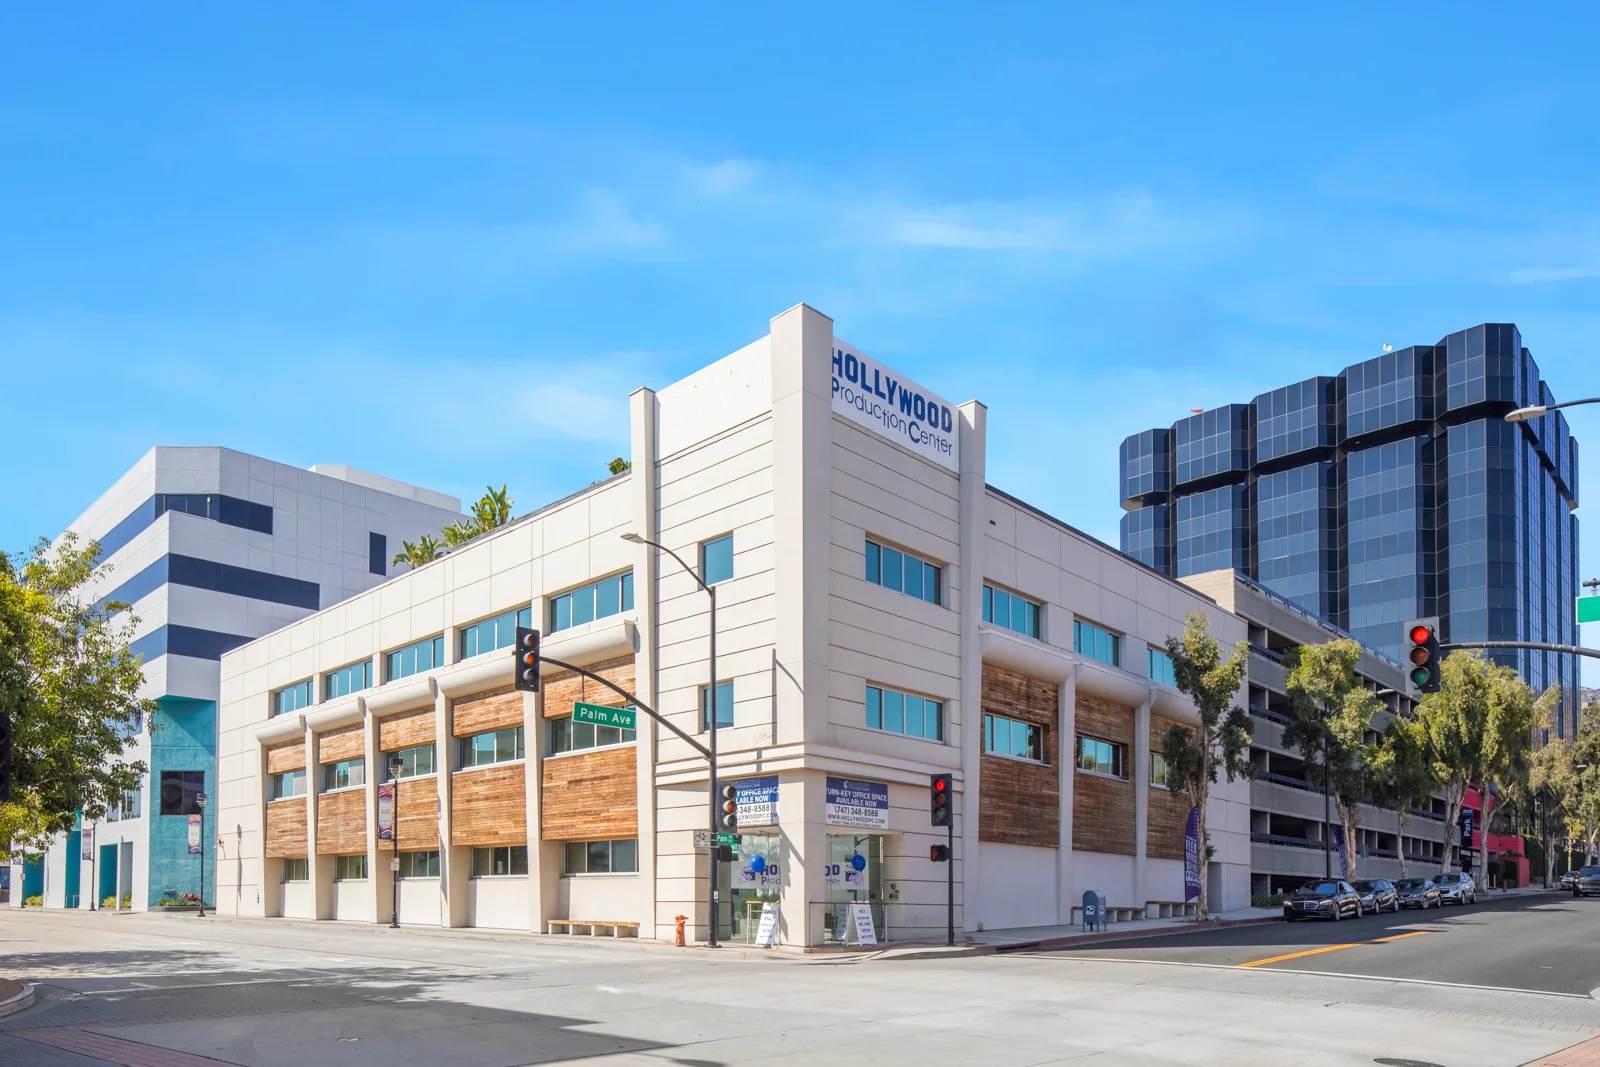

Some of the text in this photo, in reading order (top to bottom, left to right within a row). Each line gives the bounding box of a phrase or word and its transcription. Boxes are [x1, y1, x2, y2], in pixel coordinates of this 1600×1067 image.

[832, 347, 952, 433] HOLLYWOOD
[832, 376, 952, 456] Production Center
[580, 708, 631, 724] Palm Ave
[741, 788, 761, 796] OFFICE
[852, 791, 871, 799] OFFICE
[871, 793, 887, 801] SPACE
[835, 797, 864, 806] AVAILABLE
[739, 804, 770, 813] 348-8588
[834, 806, 878, 817] (747) 348-8588
